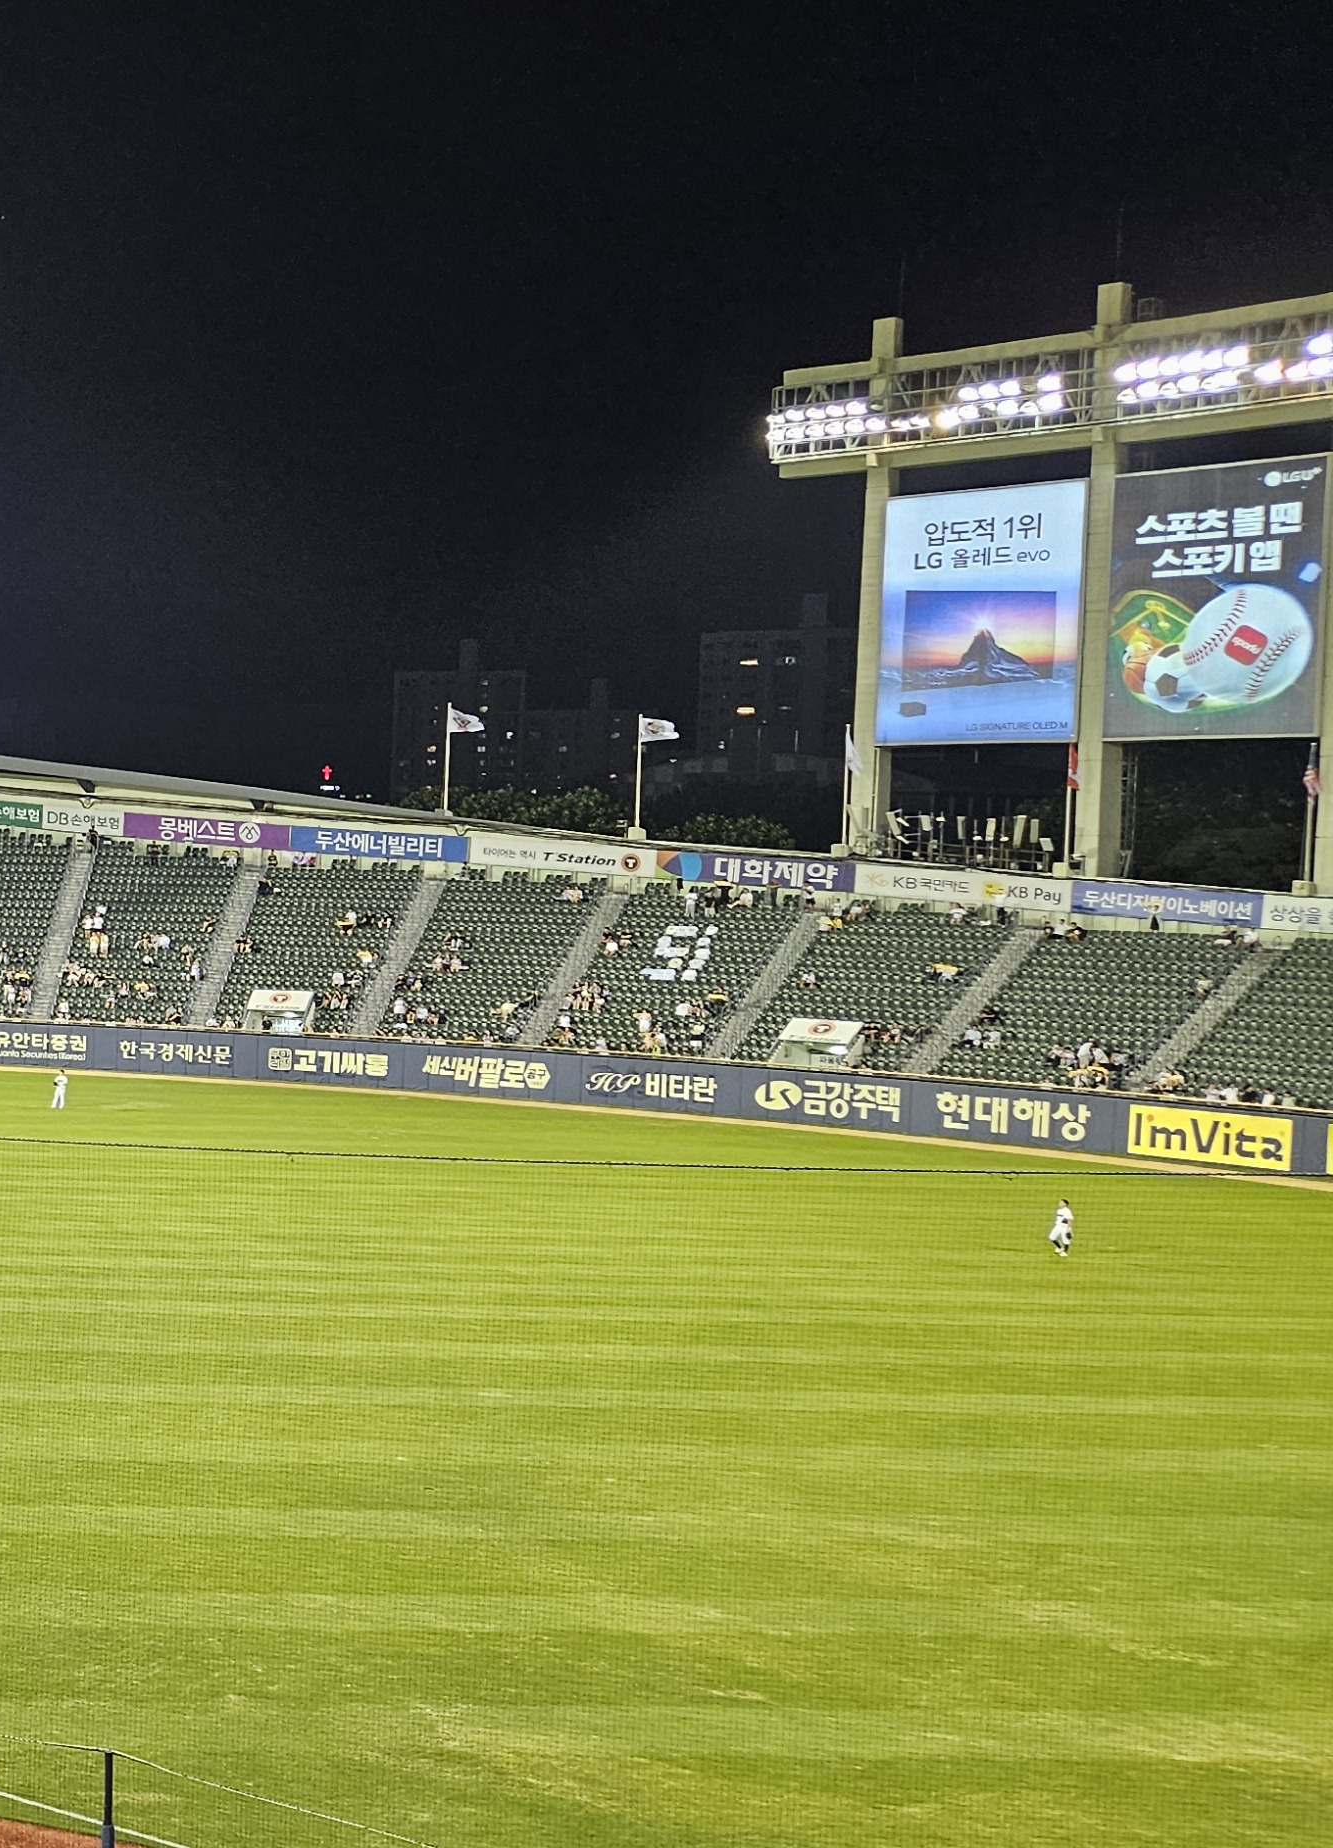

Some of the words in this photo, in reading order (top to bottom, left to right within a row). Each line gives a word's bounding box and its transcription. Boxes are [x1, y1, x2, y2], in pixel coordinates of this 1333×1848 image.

[924, 516, 995, 547] 압도적
[1003, 512, 1042, 539] 1위
[1135, 509, 1228, 545] 스포츠
[914, 552, 943, 570] LG
[950, 546, 1013, 569] 올레드
[1016, 549, 1050, 563] evo
[1151, 543, 1245, 579] 스포키
[1249, 539, 1282, 572] 앱
[979, 722, 1031, 731] SIGNATURE
[1032, 721, 1057, 730] OLED
[158, 816, 235, 841] 몽베스트
[314, 830, 443, 858] 두산에너빌리티
[483, 847, 517, 859] 타이어는
[543, 851, 556, 862] T
[556, 852, 616, 867] Station
[714, 856, 839, 890] 대화제약
[1008, 885, 1028, 899] KB
[1034, 887, 1062, 905] Pay
[1269, 905, 1322, 924] 상상을
[20, 1050, 58, 1060] Securities
[119, 1040, 232, 1065] 한국경제신문
[293, 1048, 389, 1077] 고기싸롱
[645, 1072, 717, 1103] 비타란
[803, 1080, 901, 1123] 금강주택
[936, 1091, 1091, 1142] 현대해상
